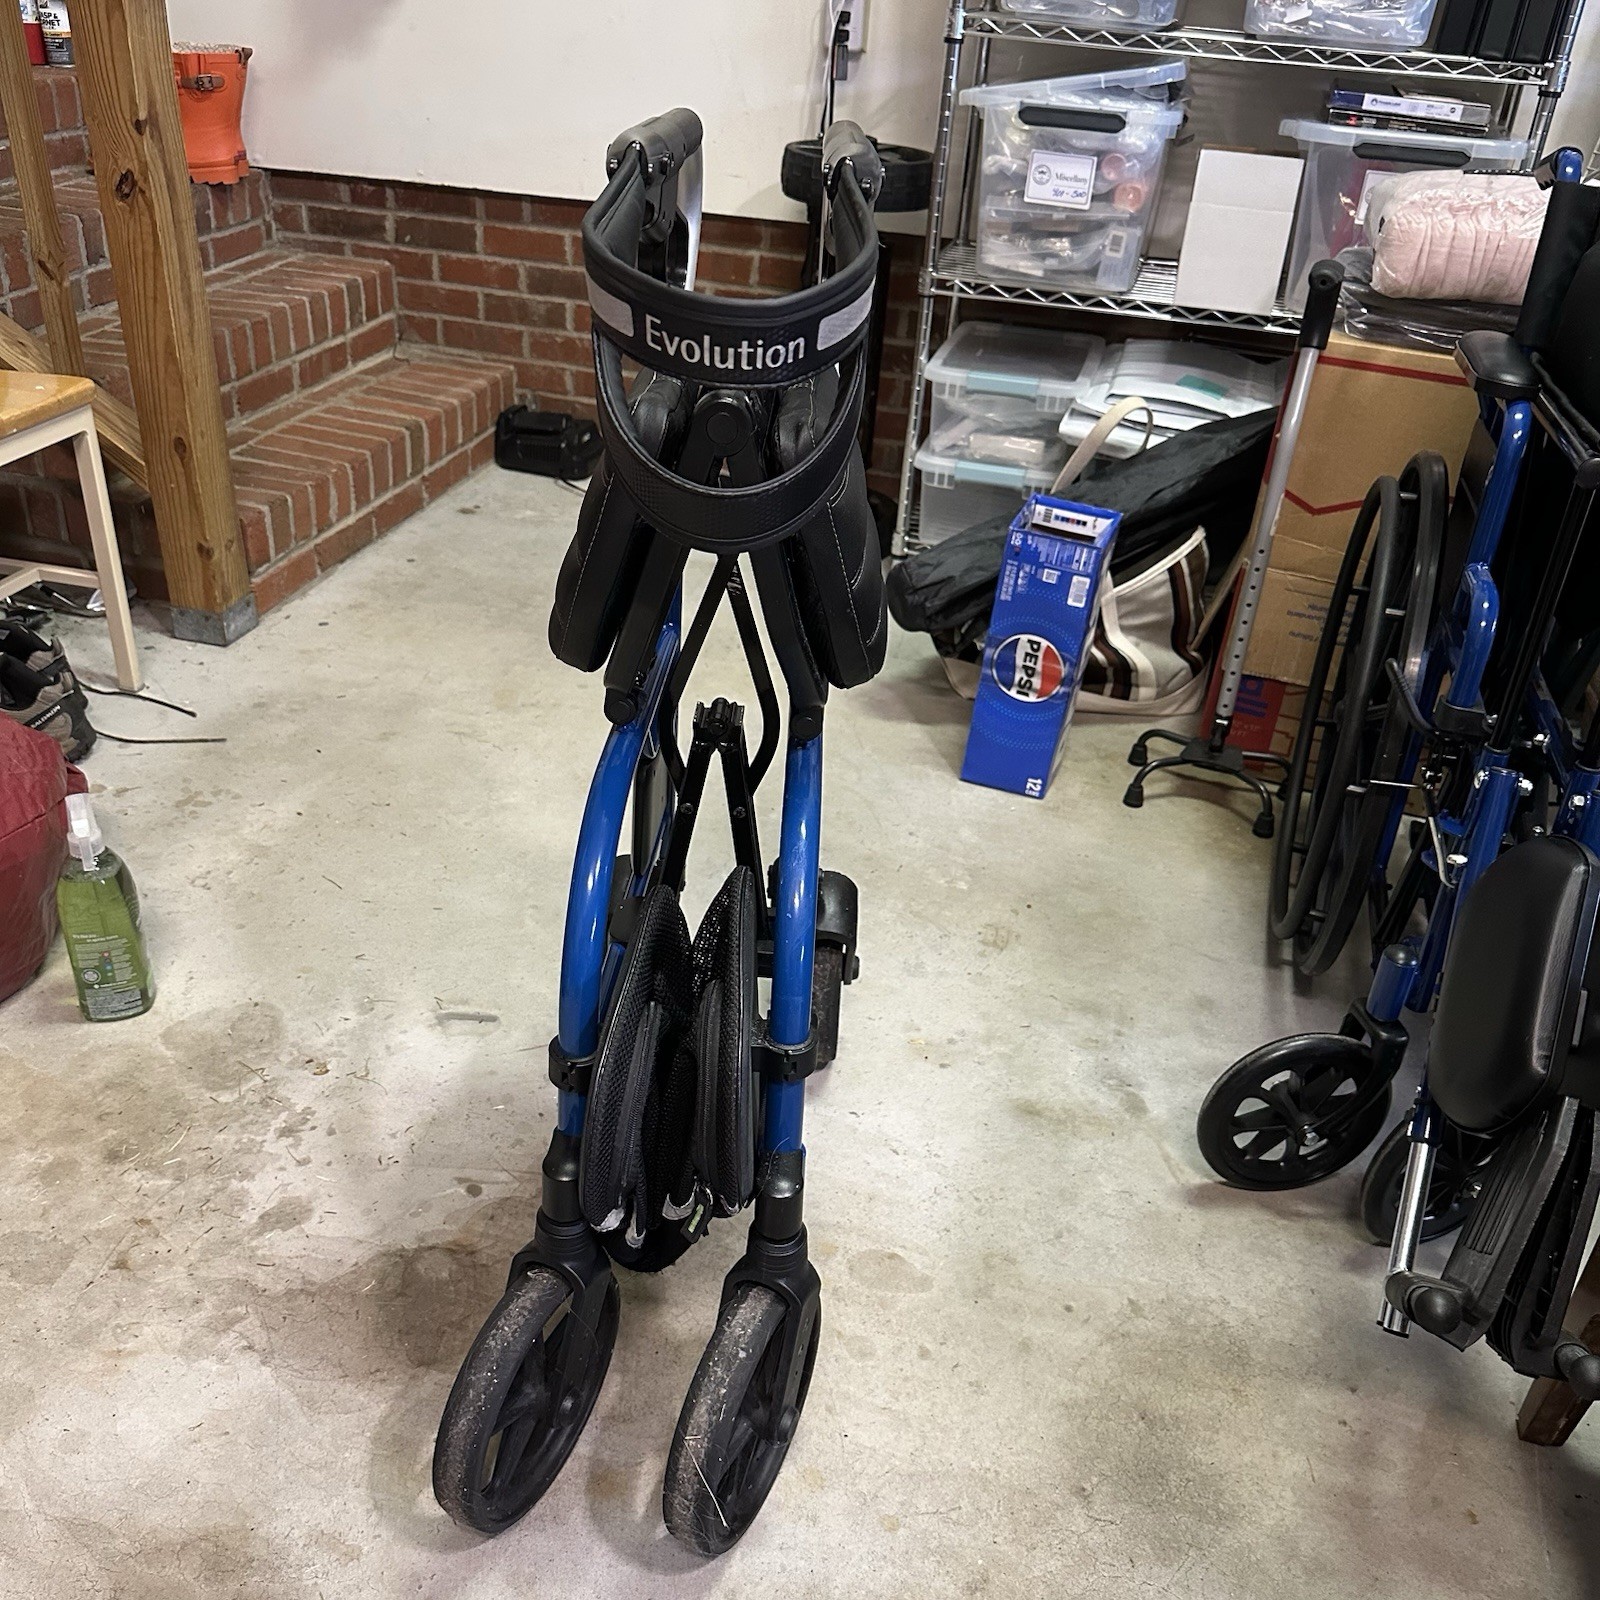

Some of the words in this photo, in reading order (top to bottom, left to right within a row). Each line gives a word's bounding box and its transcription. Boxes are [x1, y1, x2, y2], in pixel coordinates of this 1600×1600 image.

[644, 313, 806, 371] Evolution
[1016, 638, 1042, 698] PEPSI
[31, 705, 61, 729] SALOMON
[1026, 778, 1043, 792] 12
